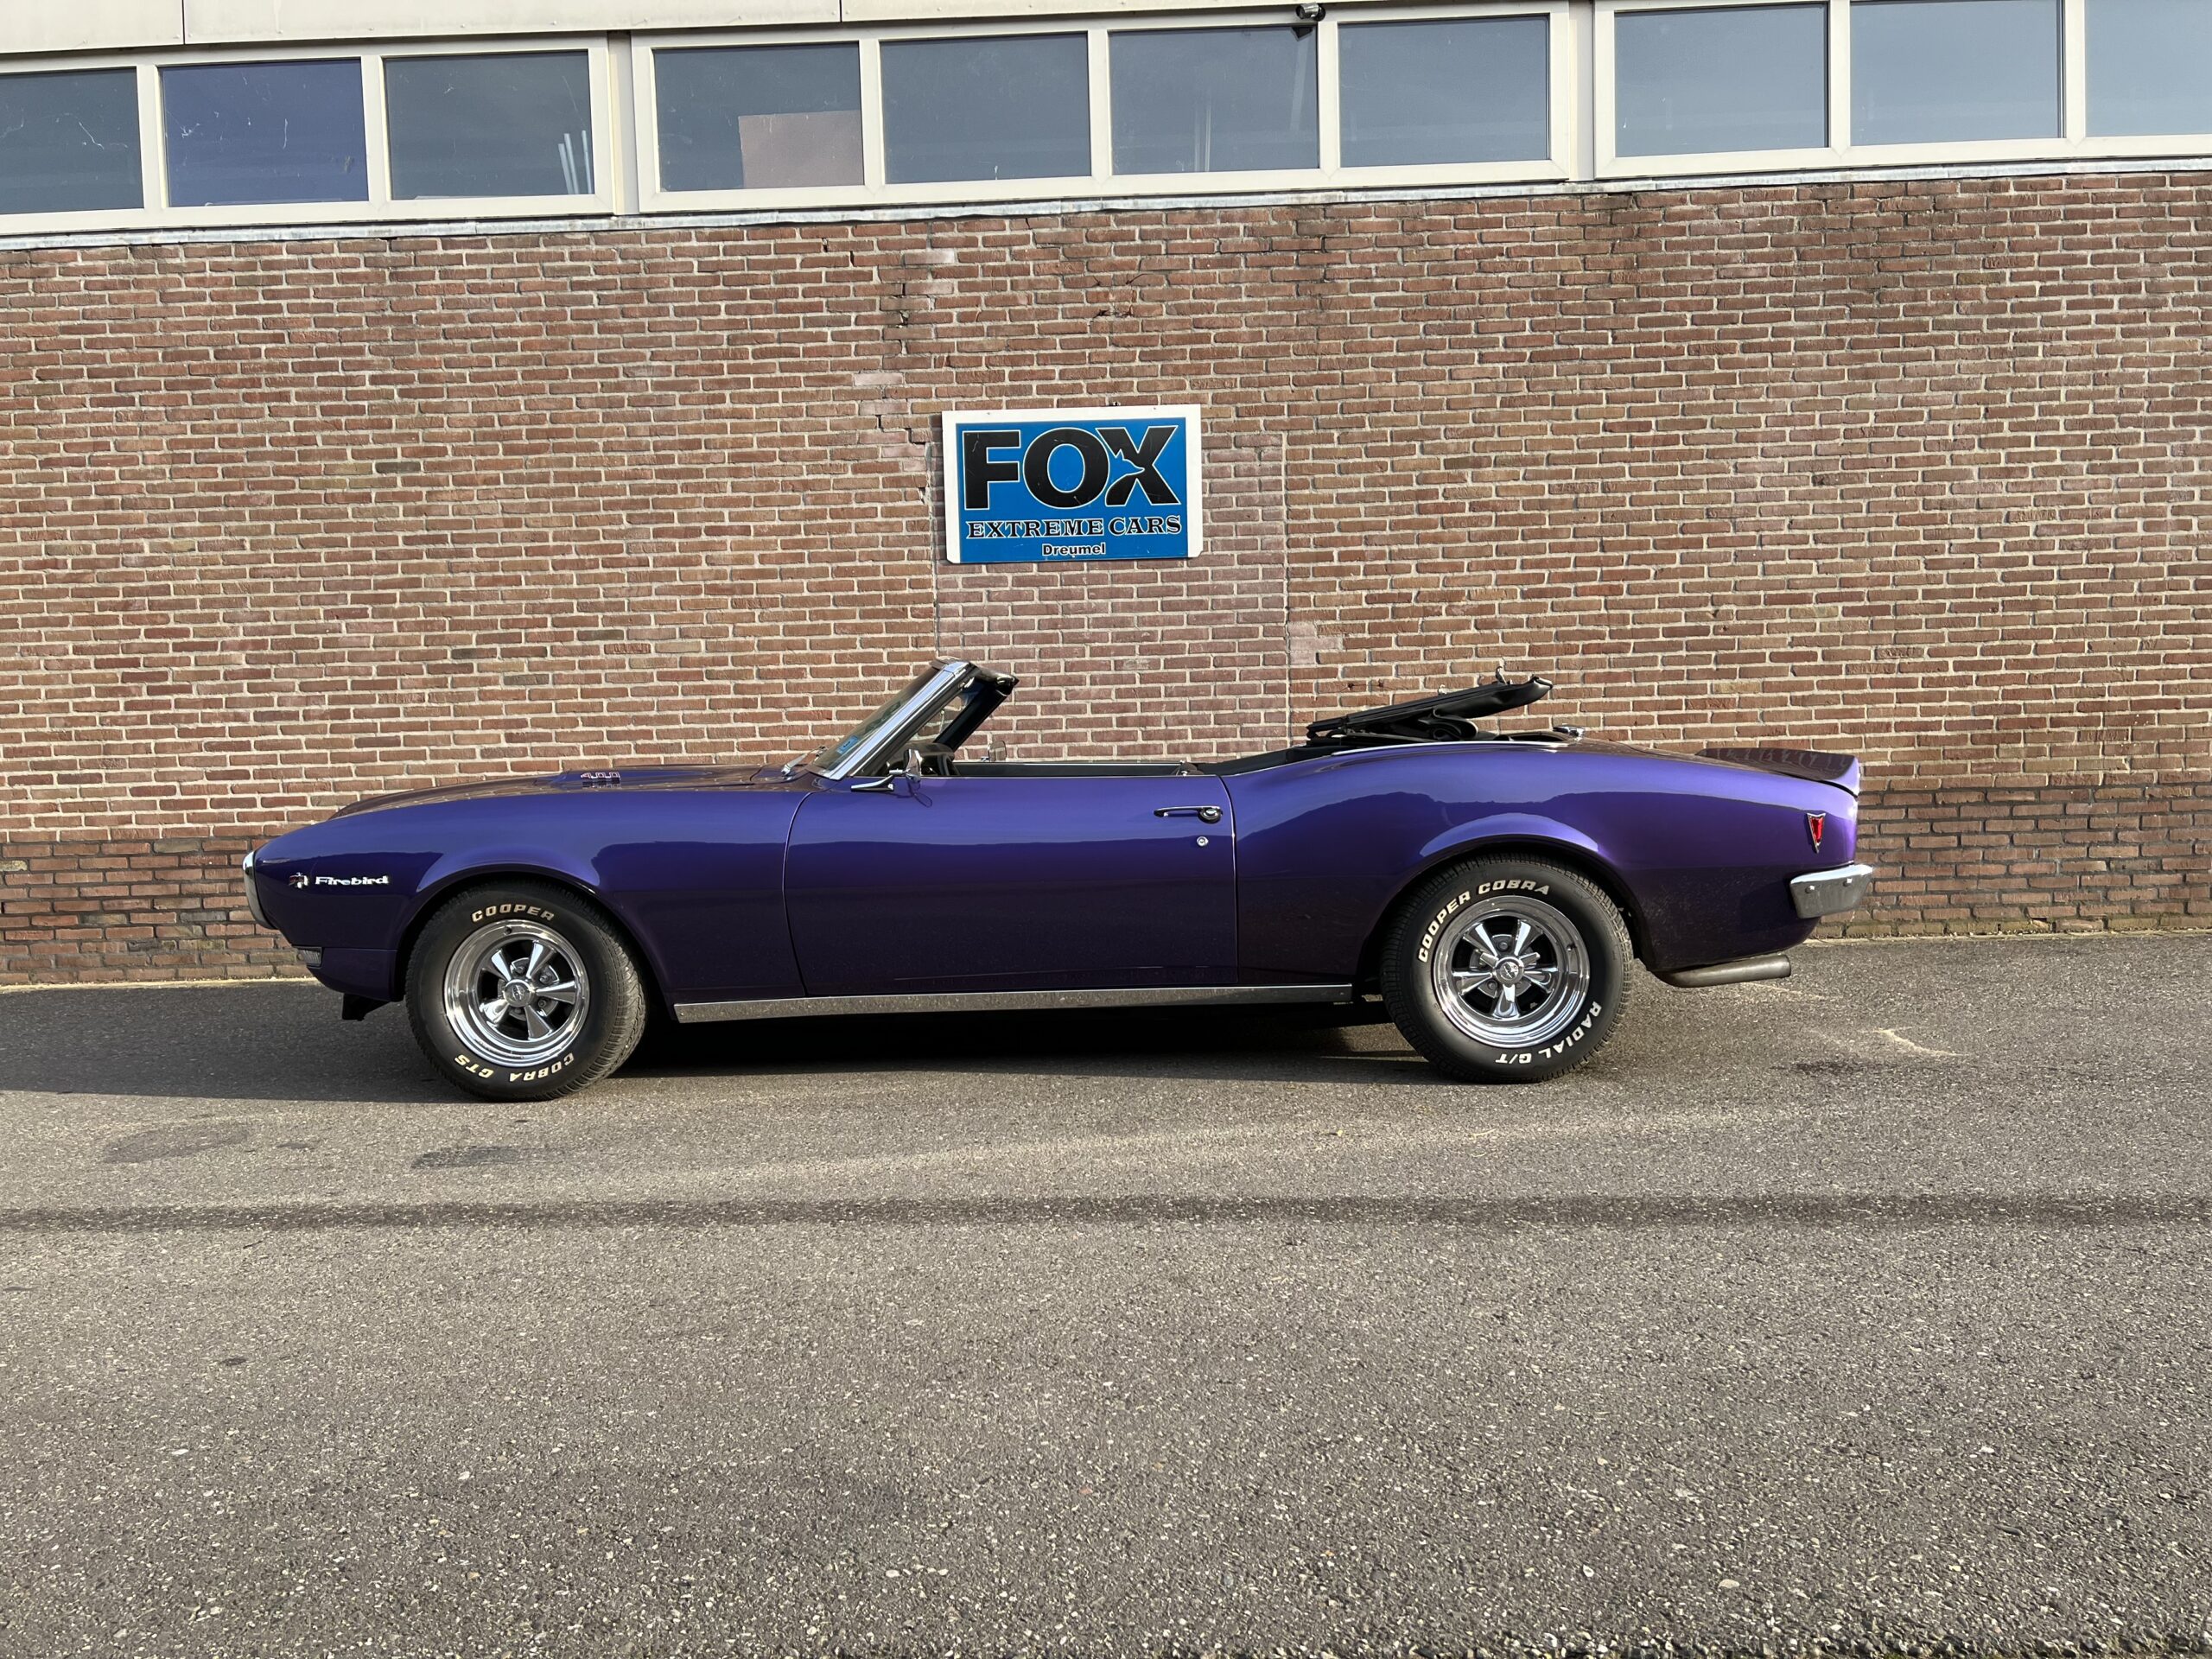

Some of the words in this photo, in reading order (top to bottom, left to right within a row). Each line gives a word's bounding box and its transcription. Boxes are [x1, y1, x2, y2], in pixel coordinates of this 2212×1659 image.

[962, 425, 1181, 511] FOX
[965, 518, 1104, 539] EXTREME
[1108, 515, 1182, 536] CARS
[1041, 542, 1106, 556] Dreumel
[315, 875, 389, 886] Firebird
[471, 904, 555, 922] COOPER
[1418, 891, 1471, 963] COOPER
[1478, 880, 1550, 895] COBRA
[1538, 1001, 1602, 1058] RADIAL
[454, 1053, 494, 1079] GTS
[509, 1052, 575, 1083] COBRA
